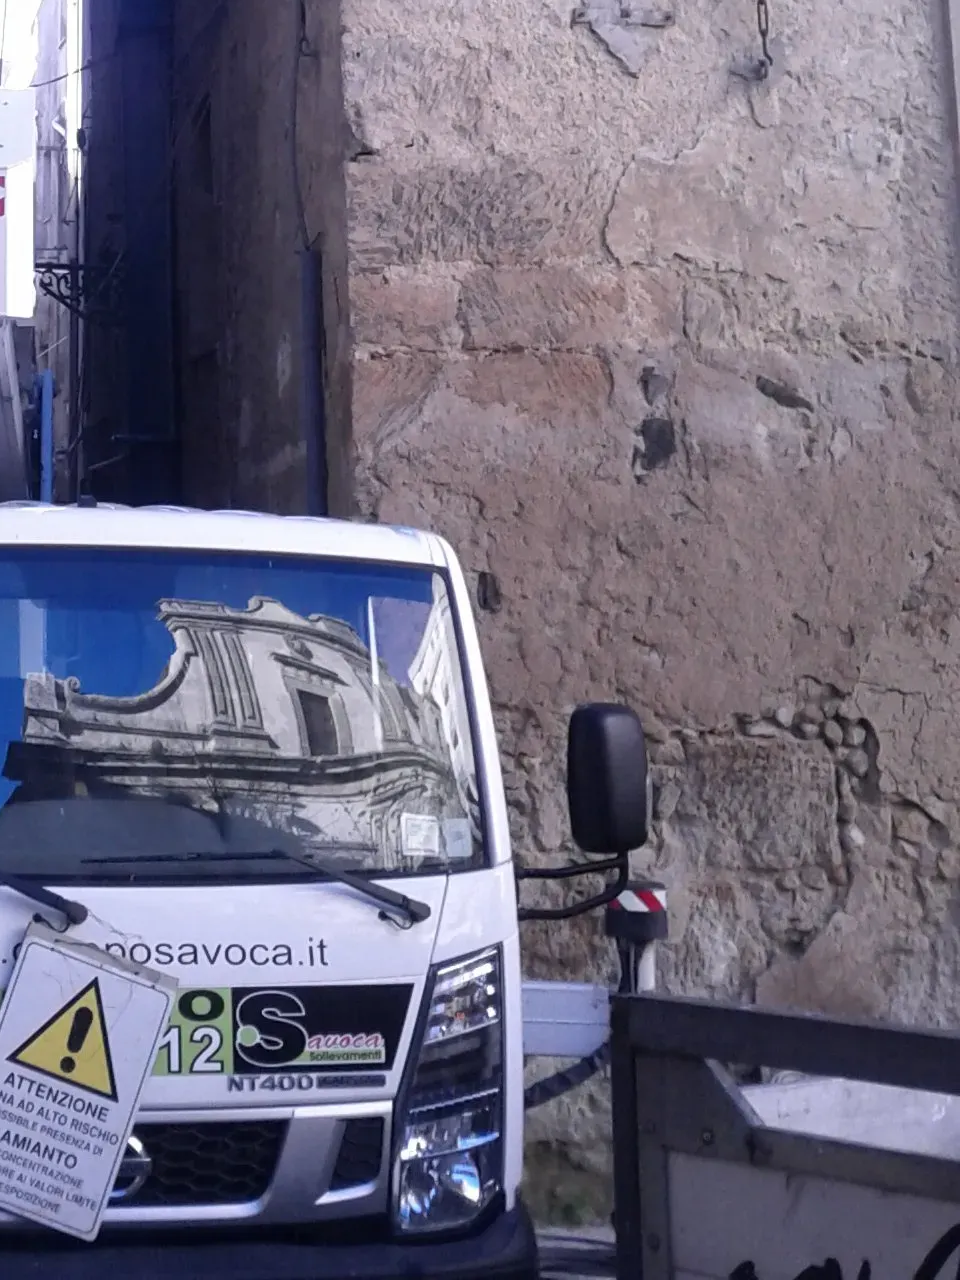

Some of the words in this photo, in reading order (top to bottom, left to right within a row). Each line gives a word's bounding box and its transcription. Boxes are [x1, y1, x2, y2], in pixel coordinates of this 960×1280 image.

[4, 1072, 109, 1123] ATTENZIONE
[227, 1075, 314, 1092] NT400
[17, 1099, 35, 1113] AD
[36, 1106, 68, 1126] ALTO
[70, 1118, 119, 1145] RISCHIO
[40, 1125, 91, 1152] PRESENZA
[93, 1145, 103, 1157] DI
[0, 1130, 78, 1169] AMIANTO
[16, 1172, 27, 1183] AI
[30, 1179, 64, 1197] VALORI
[65, 1192, 98, 1211] LIMITE
